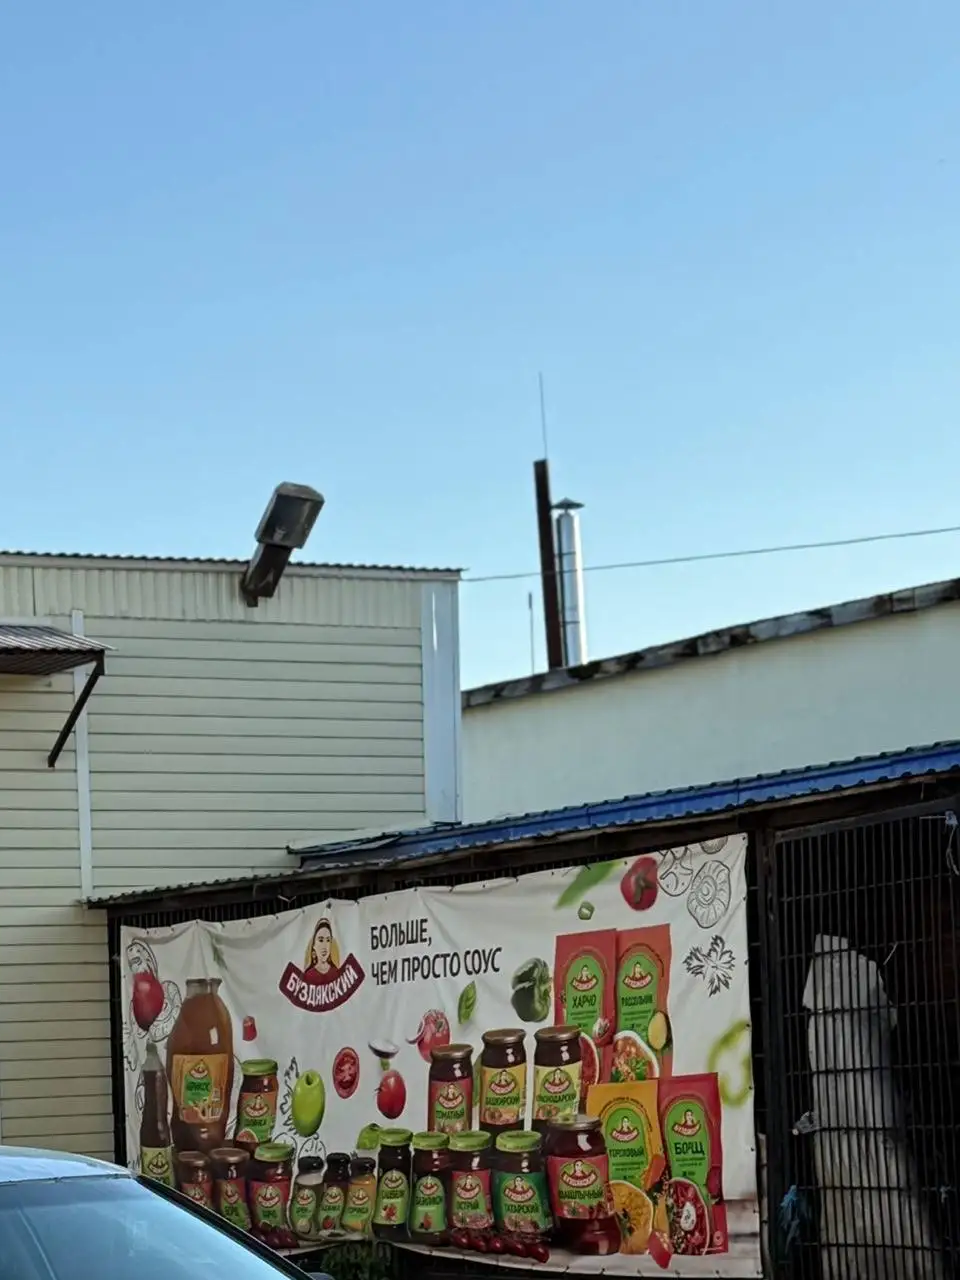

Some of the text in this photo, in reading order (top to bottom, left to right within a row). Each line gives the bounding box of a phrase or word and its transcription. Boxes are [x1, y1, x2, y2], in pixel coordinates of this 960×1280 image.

[370, 918, 432, 951] БОЛЬШЕ,
[371, 946, 503, 986] ЧЕМ ПРОСТО СОУС
[285, 964, 359, 1007] БУЗДЯКСКИЙ
[571, 994, 597, 1009] ХАРЧО
[674, 1141, 705, 1156] БОРЩ
